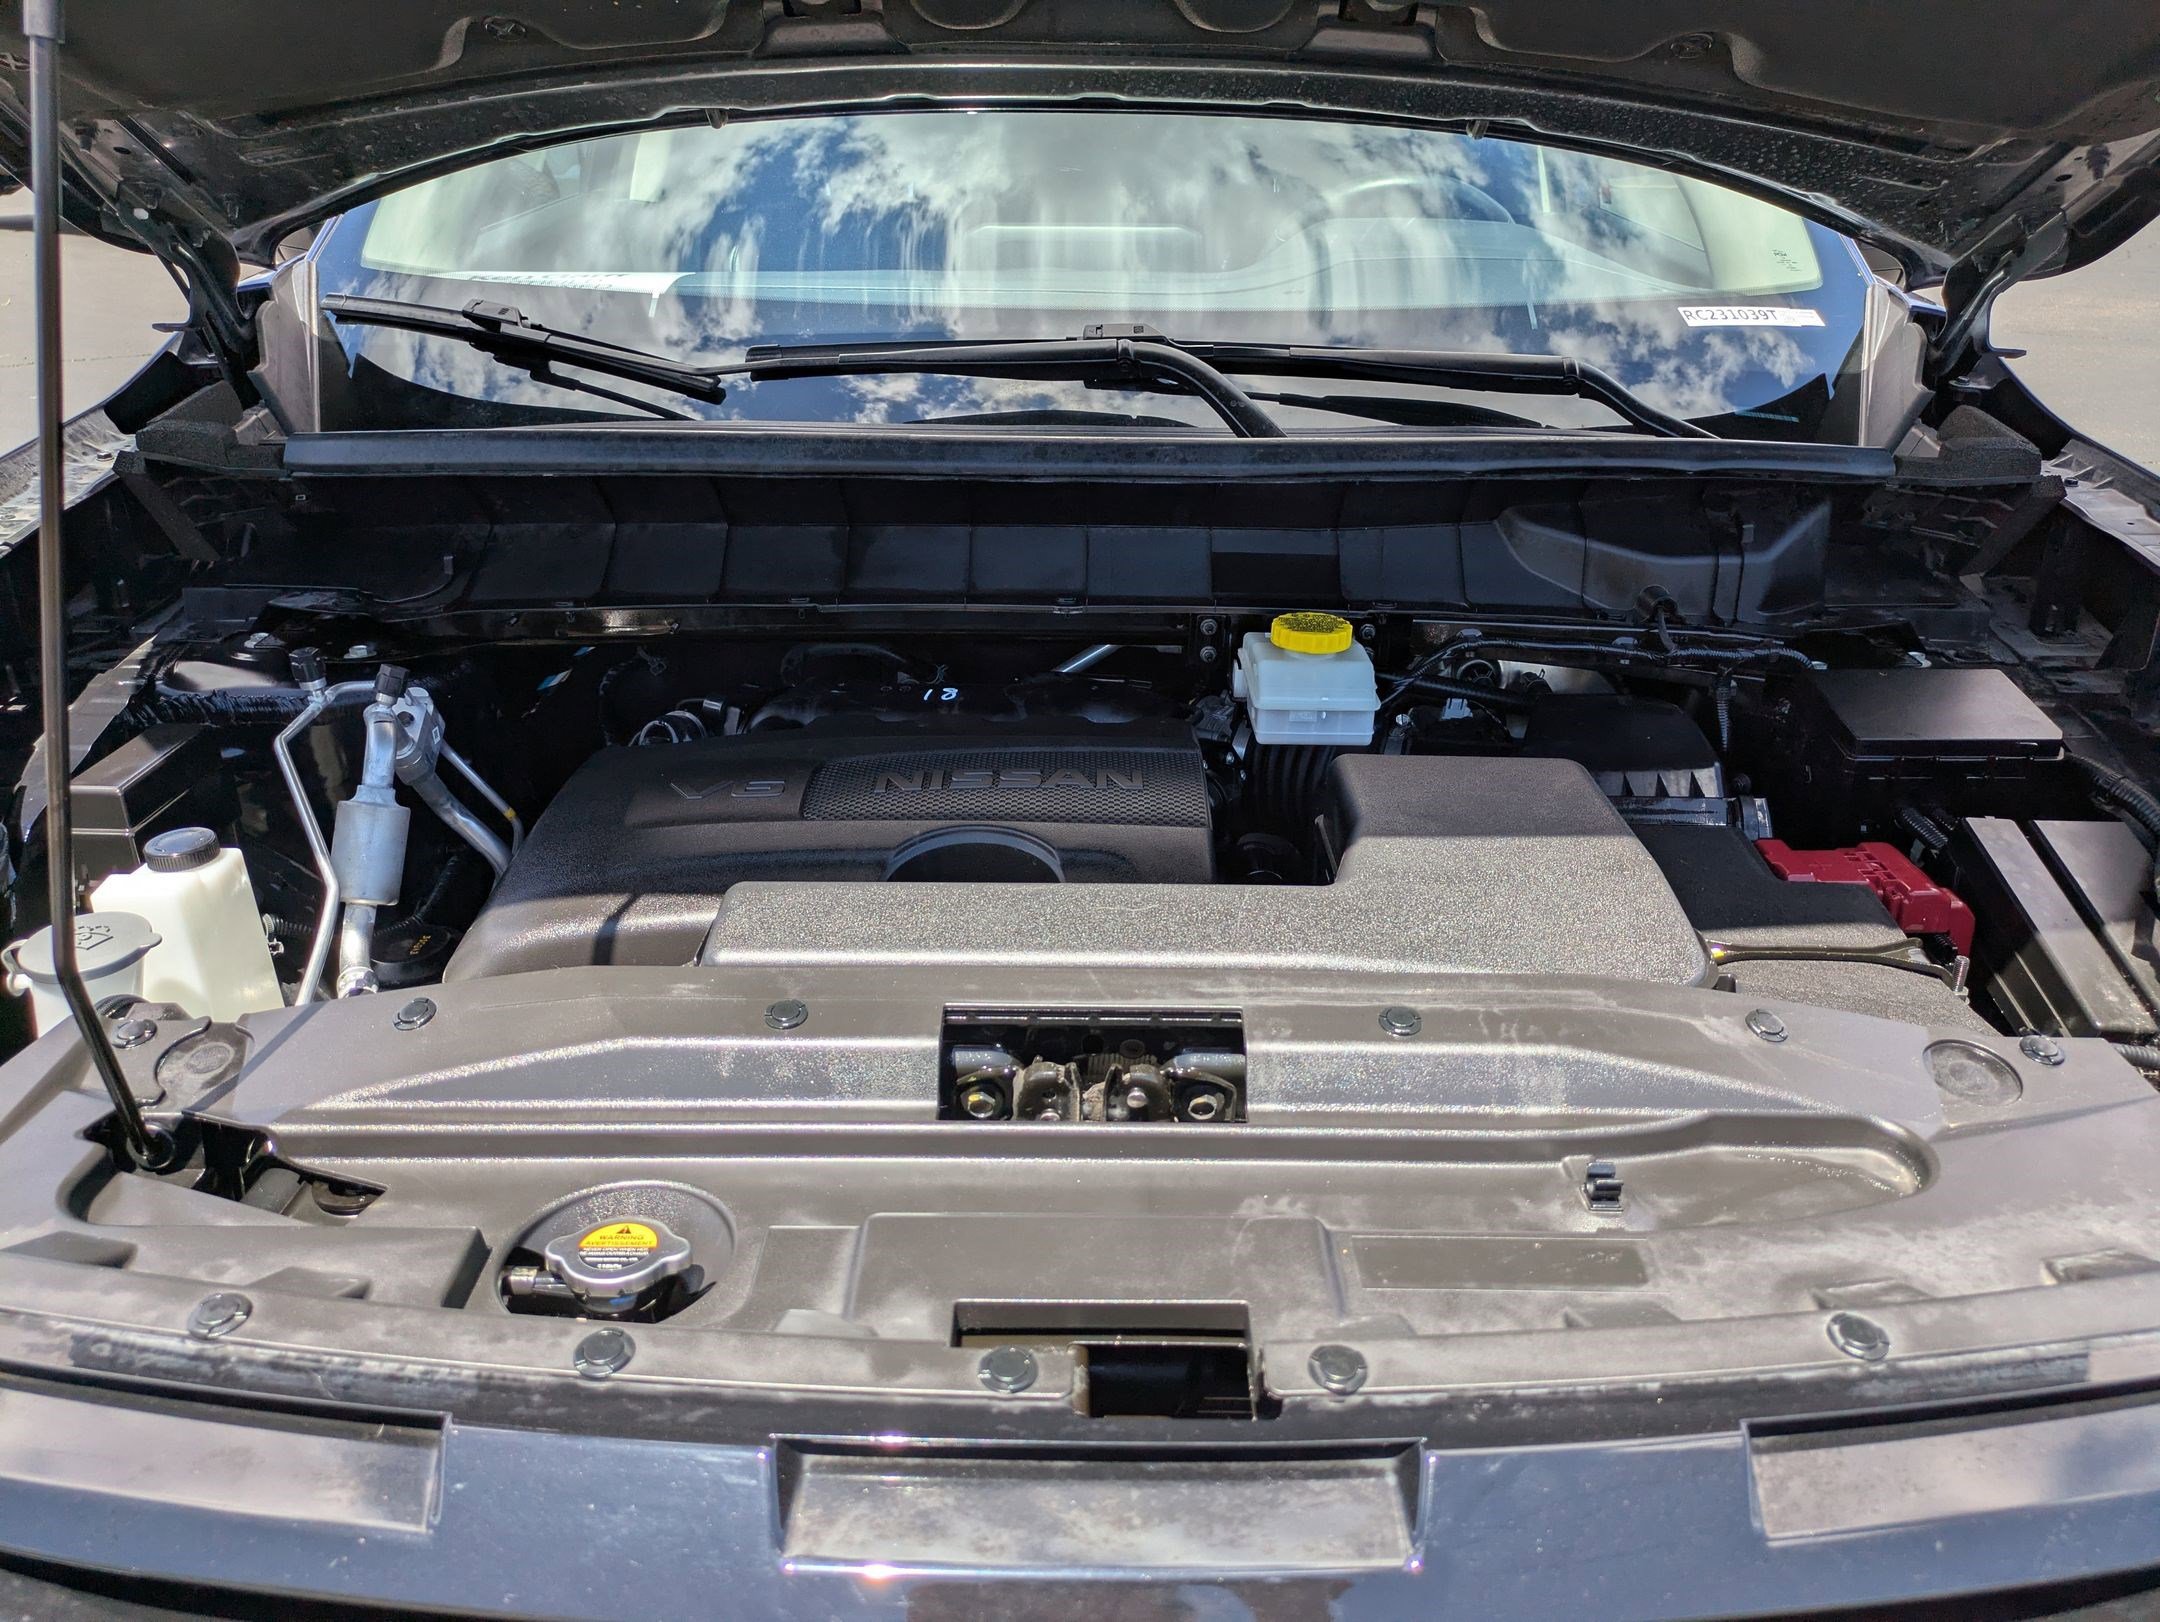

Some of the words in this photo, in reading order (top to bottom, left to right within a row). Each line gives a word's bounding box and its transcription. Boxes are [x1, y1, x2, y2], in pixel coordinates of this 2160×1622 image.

[1682, 309, 1778, 321] RC231039T
[667, 780, 786, 799] V6
[874, 768, 1145, 793] NISSAN
